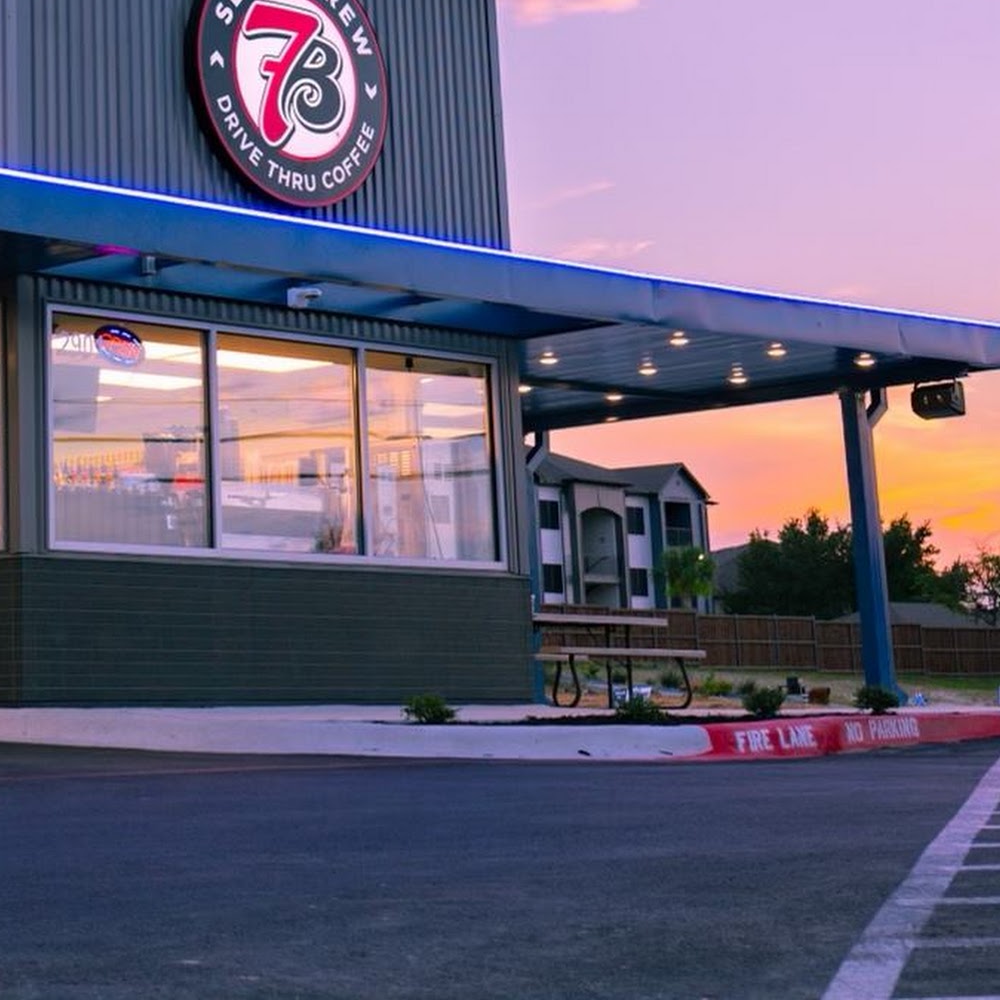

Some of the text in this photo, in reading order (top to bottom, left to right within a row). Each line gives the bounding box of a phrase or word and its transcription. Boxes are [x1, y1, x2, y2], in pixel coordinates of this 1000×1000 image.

[216, 94, 375, 192] DRIVE THRU COFFEE
[734, 723, 818, 753] FIRE LANE
[844, 717, 920, 743] NO PARKING
